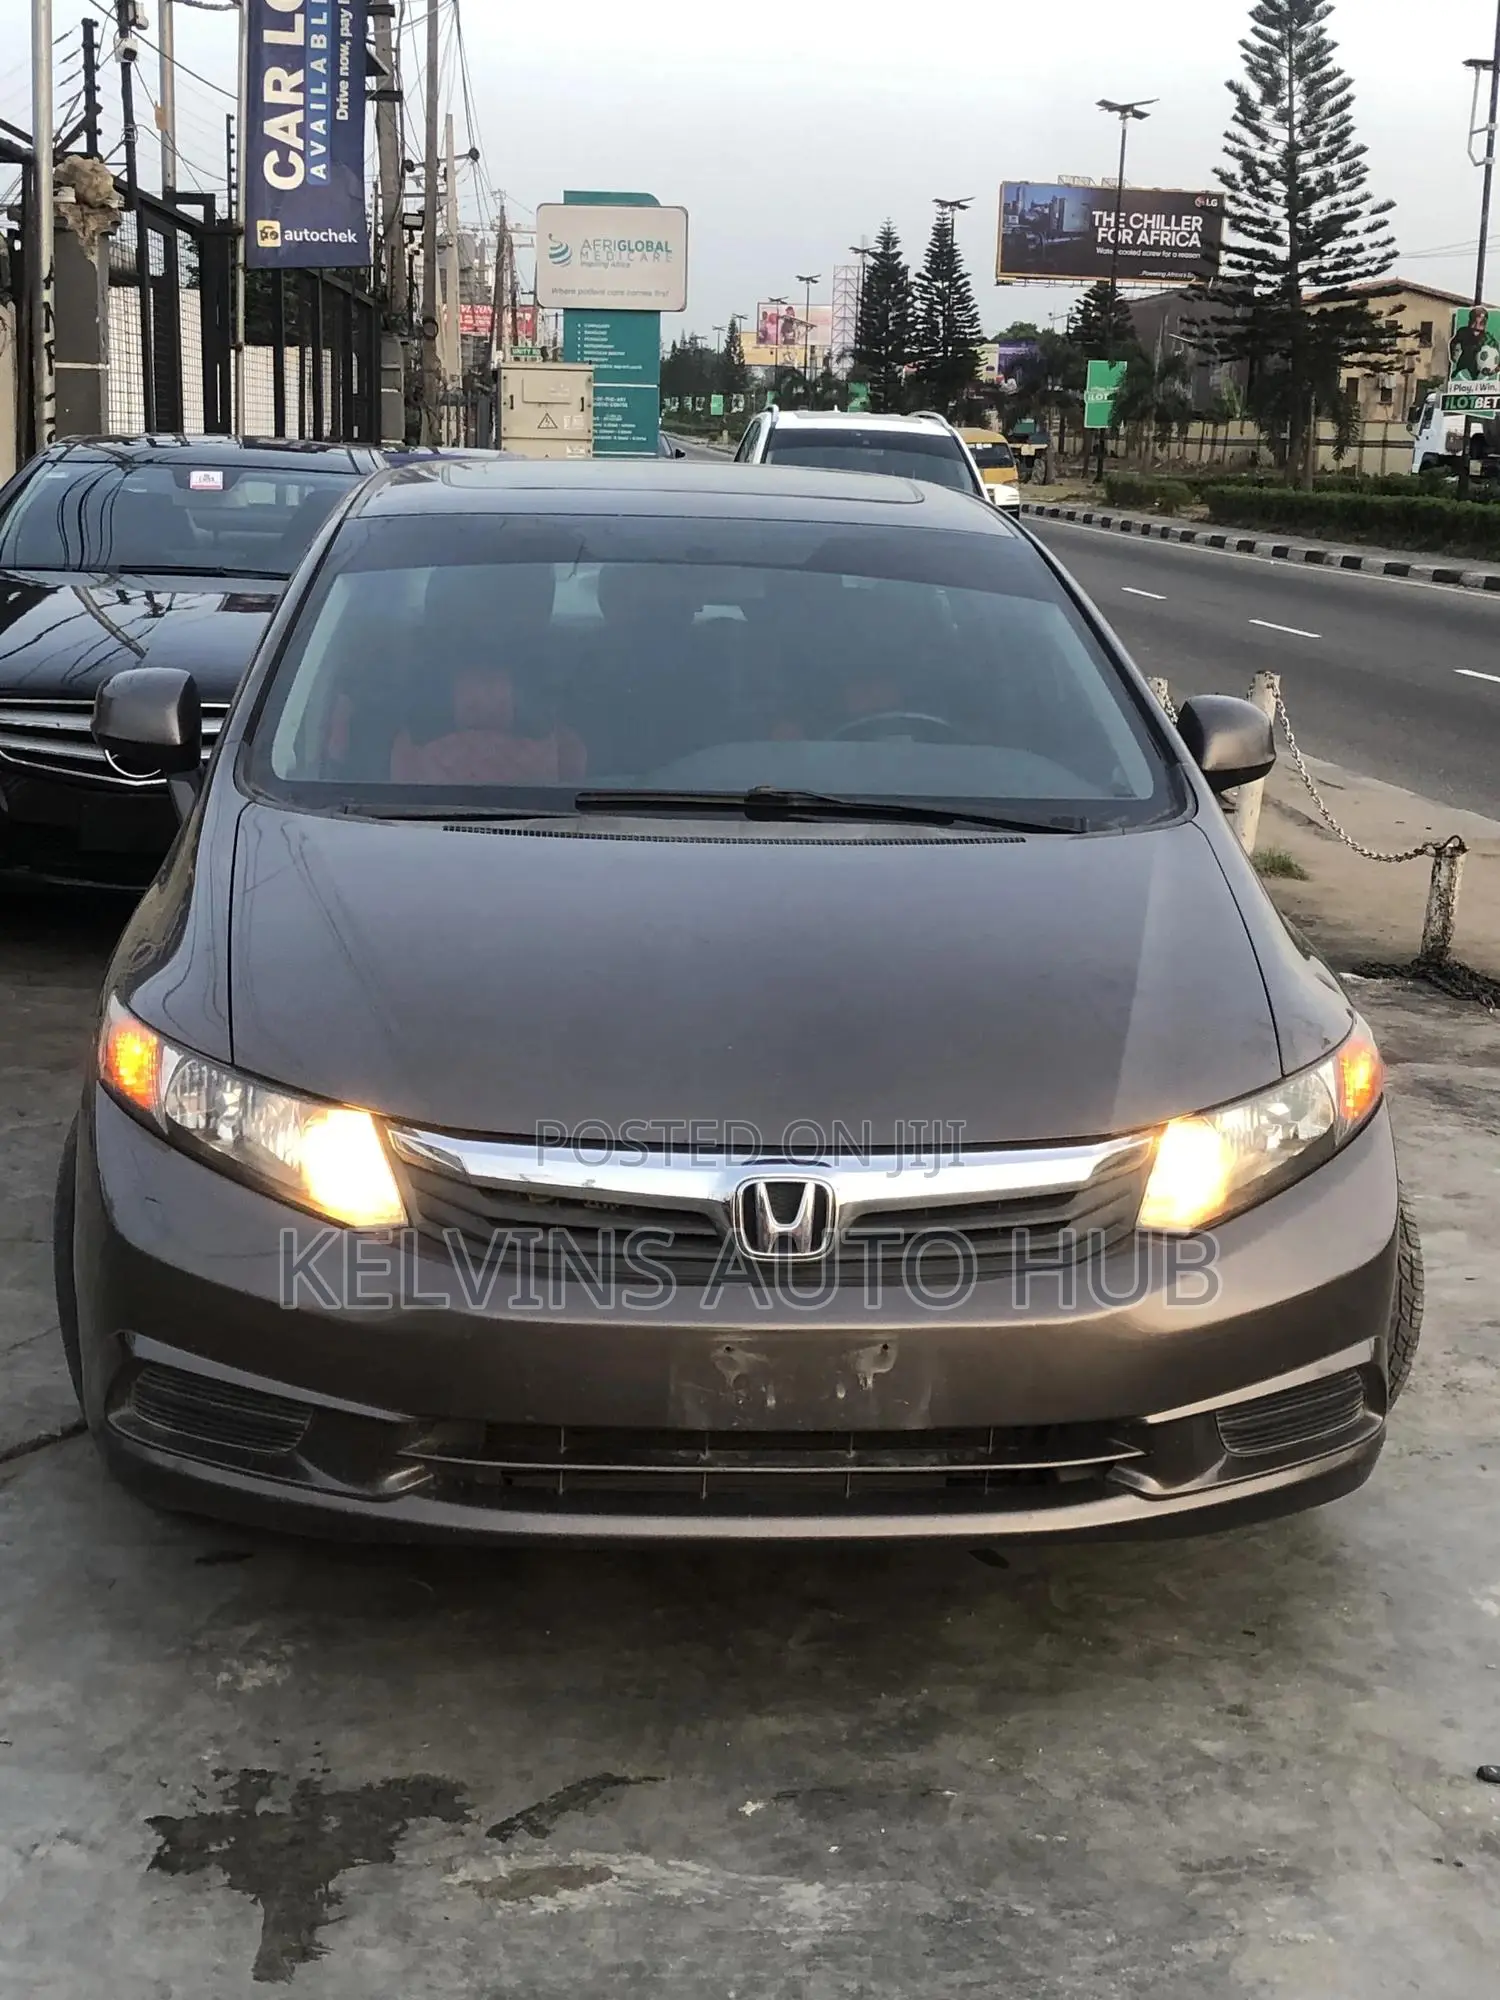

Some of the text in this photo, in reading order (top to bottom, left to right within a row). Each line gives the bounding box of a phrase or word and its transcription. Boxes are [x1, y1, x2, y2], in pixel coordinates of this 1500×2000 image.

[340, 8, 353, 37] pay
[340, 41, 352, 76] now,
[263, 0, 304, 190] CAR L
[336, 80, 349, 120] Drive
[1206, 198, 1218, 207] LG
[1092, 210, 1203, 232] THE CHILLER
[284, 228, 358, 243] autochek
[581, 238, 673, 253] AFRIGLOBAL
[1097, 227, 1201, 248] FOR AFRICA
[580, 251, 673, 263] MEDICARE
[1162, 249, 1172, 258] for
